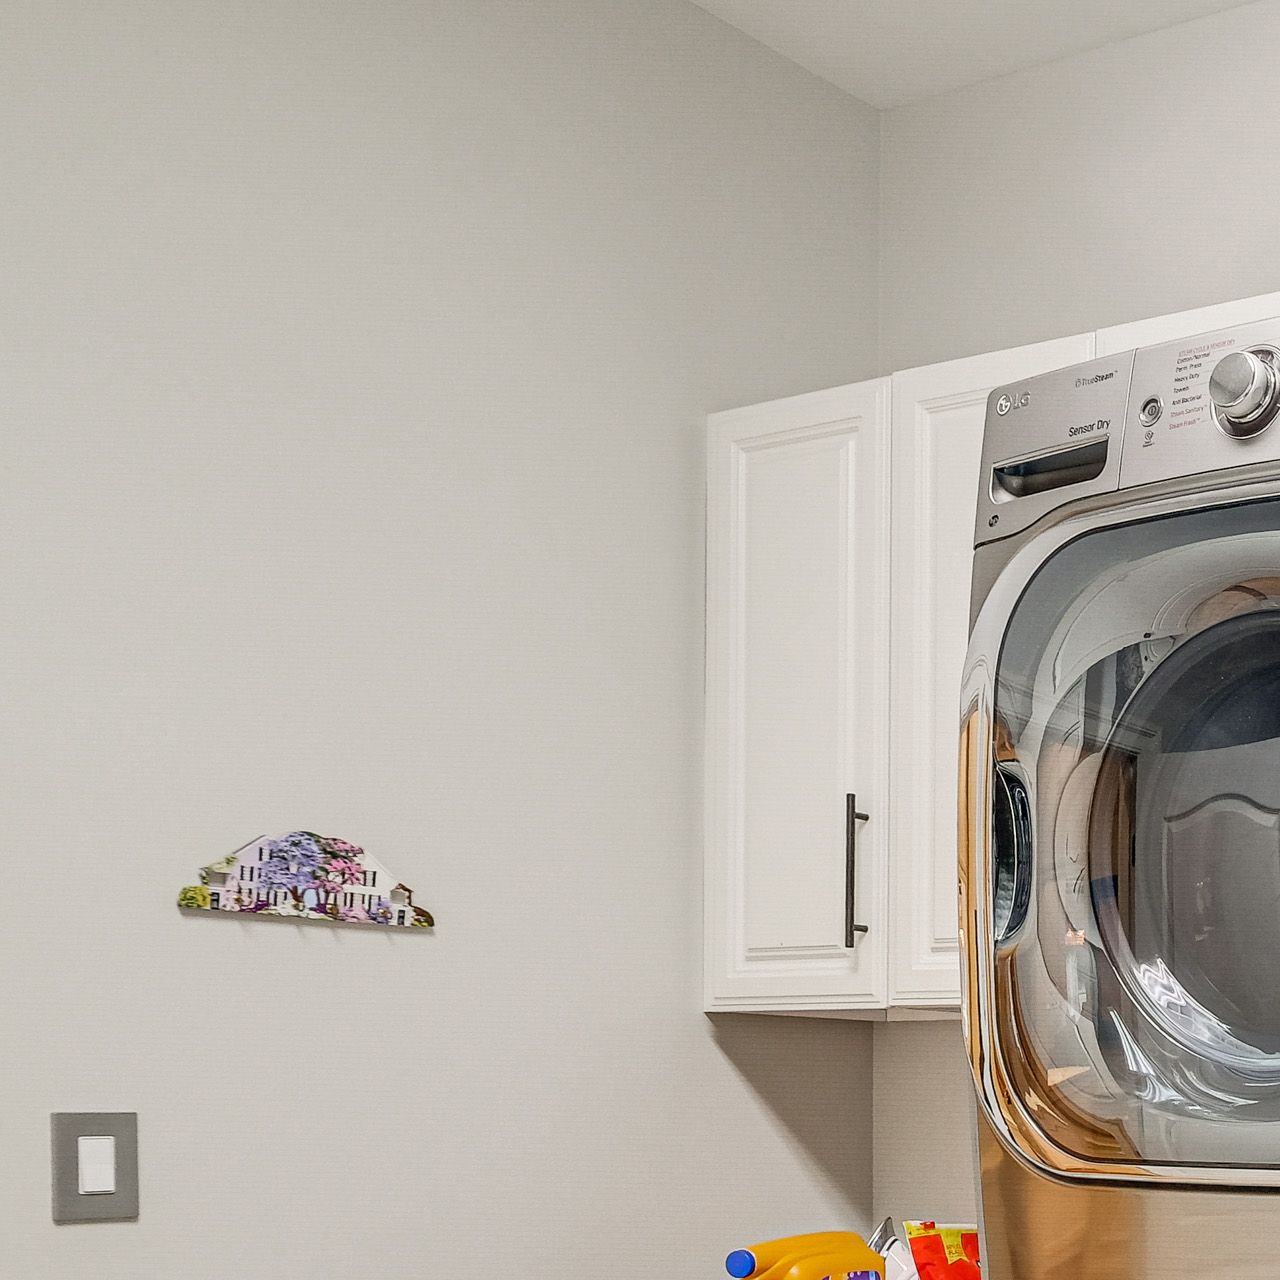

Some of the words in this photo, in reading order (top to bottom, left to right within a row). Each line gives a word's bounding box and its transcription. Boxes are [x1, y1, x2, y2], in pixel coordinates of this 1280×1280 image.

[1012, 392, 1031, 410] LG
[1068, 423, 1095, 437] Sensor
[1096, 419, 1111, 430] Dry
